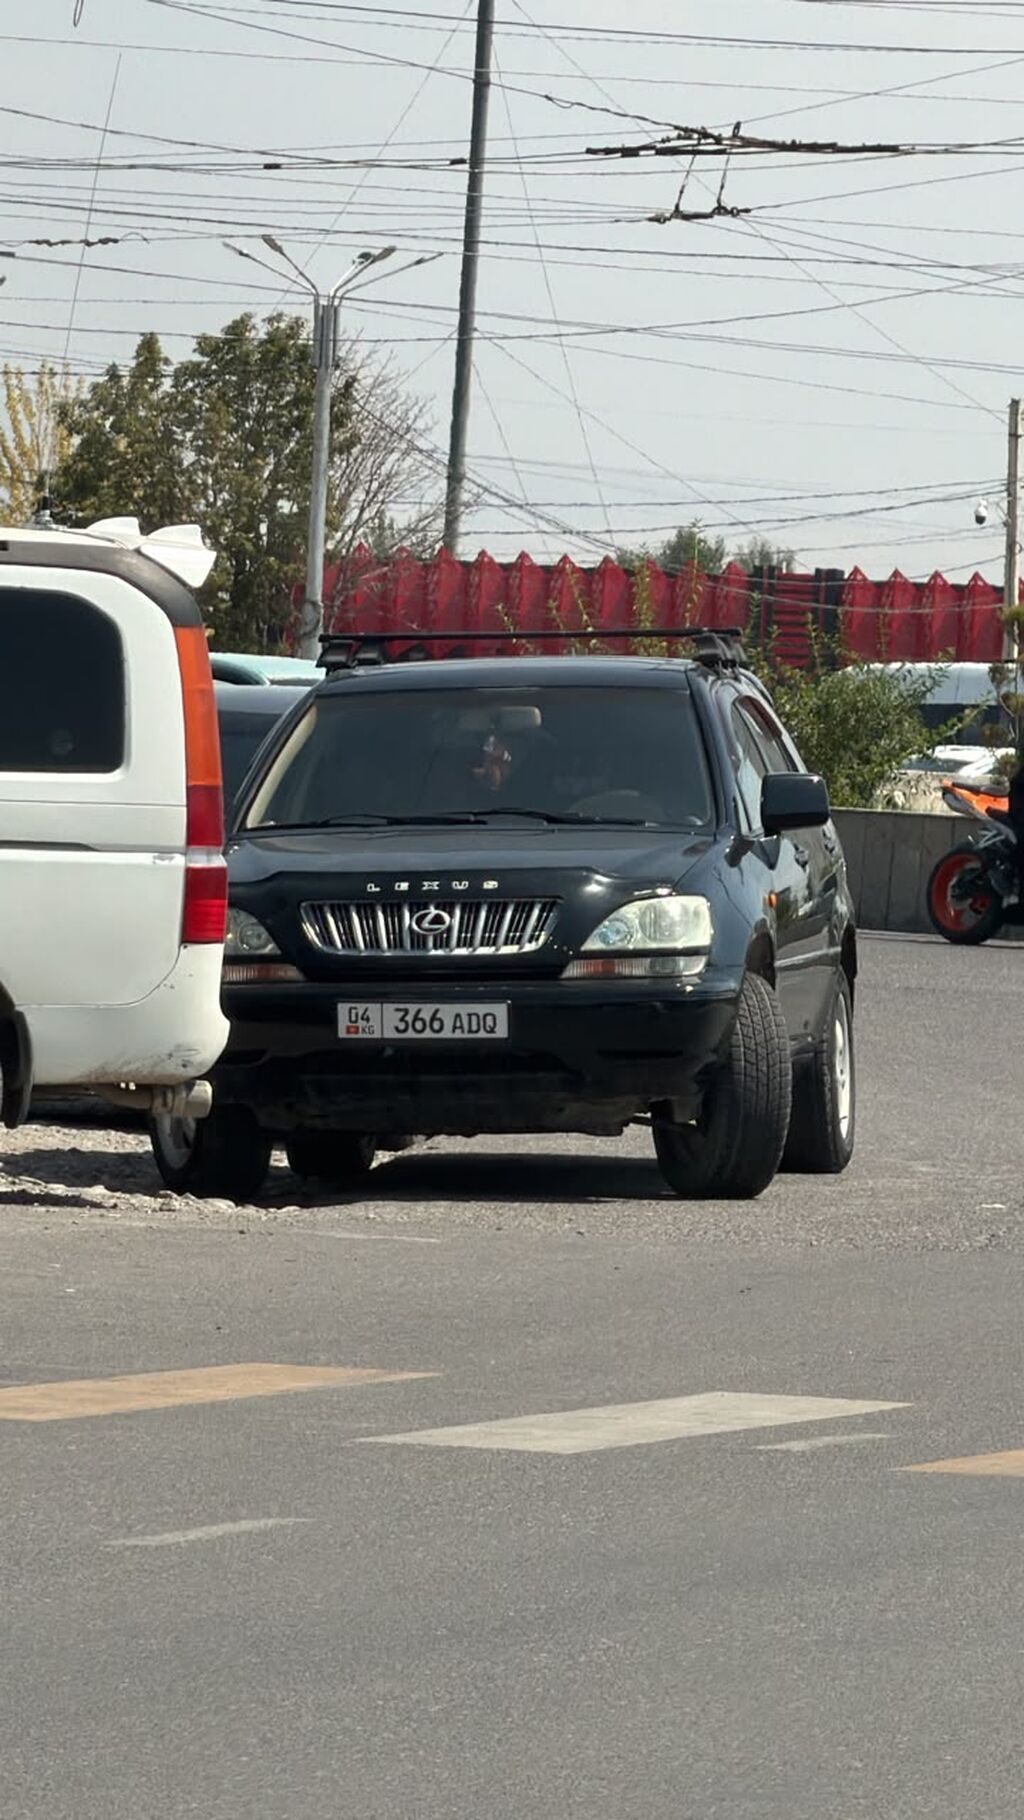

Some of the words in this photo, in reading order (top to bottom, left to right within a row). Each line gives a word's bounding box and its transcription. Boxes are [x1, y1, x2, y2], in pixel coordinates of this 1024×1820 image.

[367, 881, 498, 892] LEXUS
[348, 1006, 370, 1024] 04
[393, 1007, 444, 1034] 366
[451, 1012, 497, 1035] ADQ
[361, 1024, 374, 1035] KG
